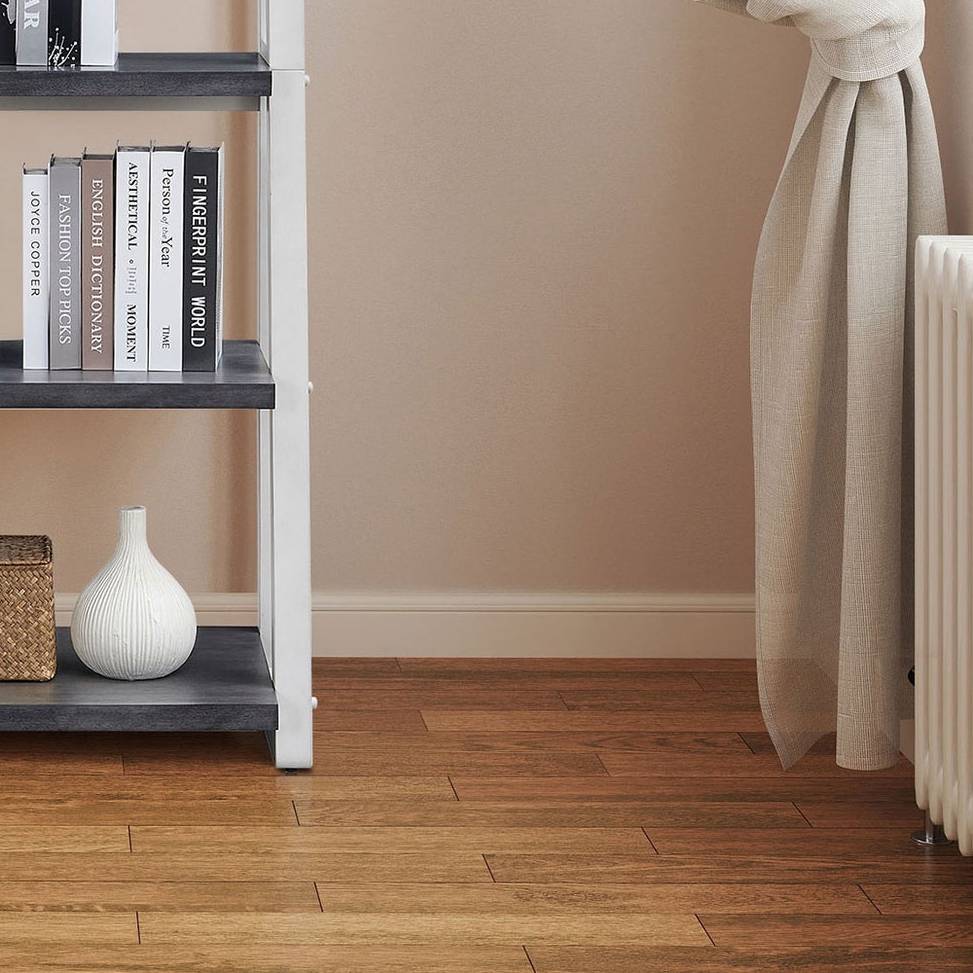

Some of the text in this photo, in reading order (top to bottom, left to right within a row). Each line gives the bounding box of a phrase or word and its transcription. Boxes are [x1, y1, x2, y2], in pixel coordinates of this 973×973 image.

[128, 162, 139, 250] AESTHETICAL
[160, 168, 174, 215] Person
[30, 191, 40, 296] JOYCE COPPER
[58, 195, 72, 345] FASHION TOP PICKS
[90, 178, 103, 354] ENGLISH DICTIONARY
[161, 237, 173, 268] Year
[190, 175, 207, 348] FINGERPRINT WORLD
[126, 304, 137, 363] MOMENT
[162, 325, 170, 350] TIME
